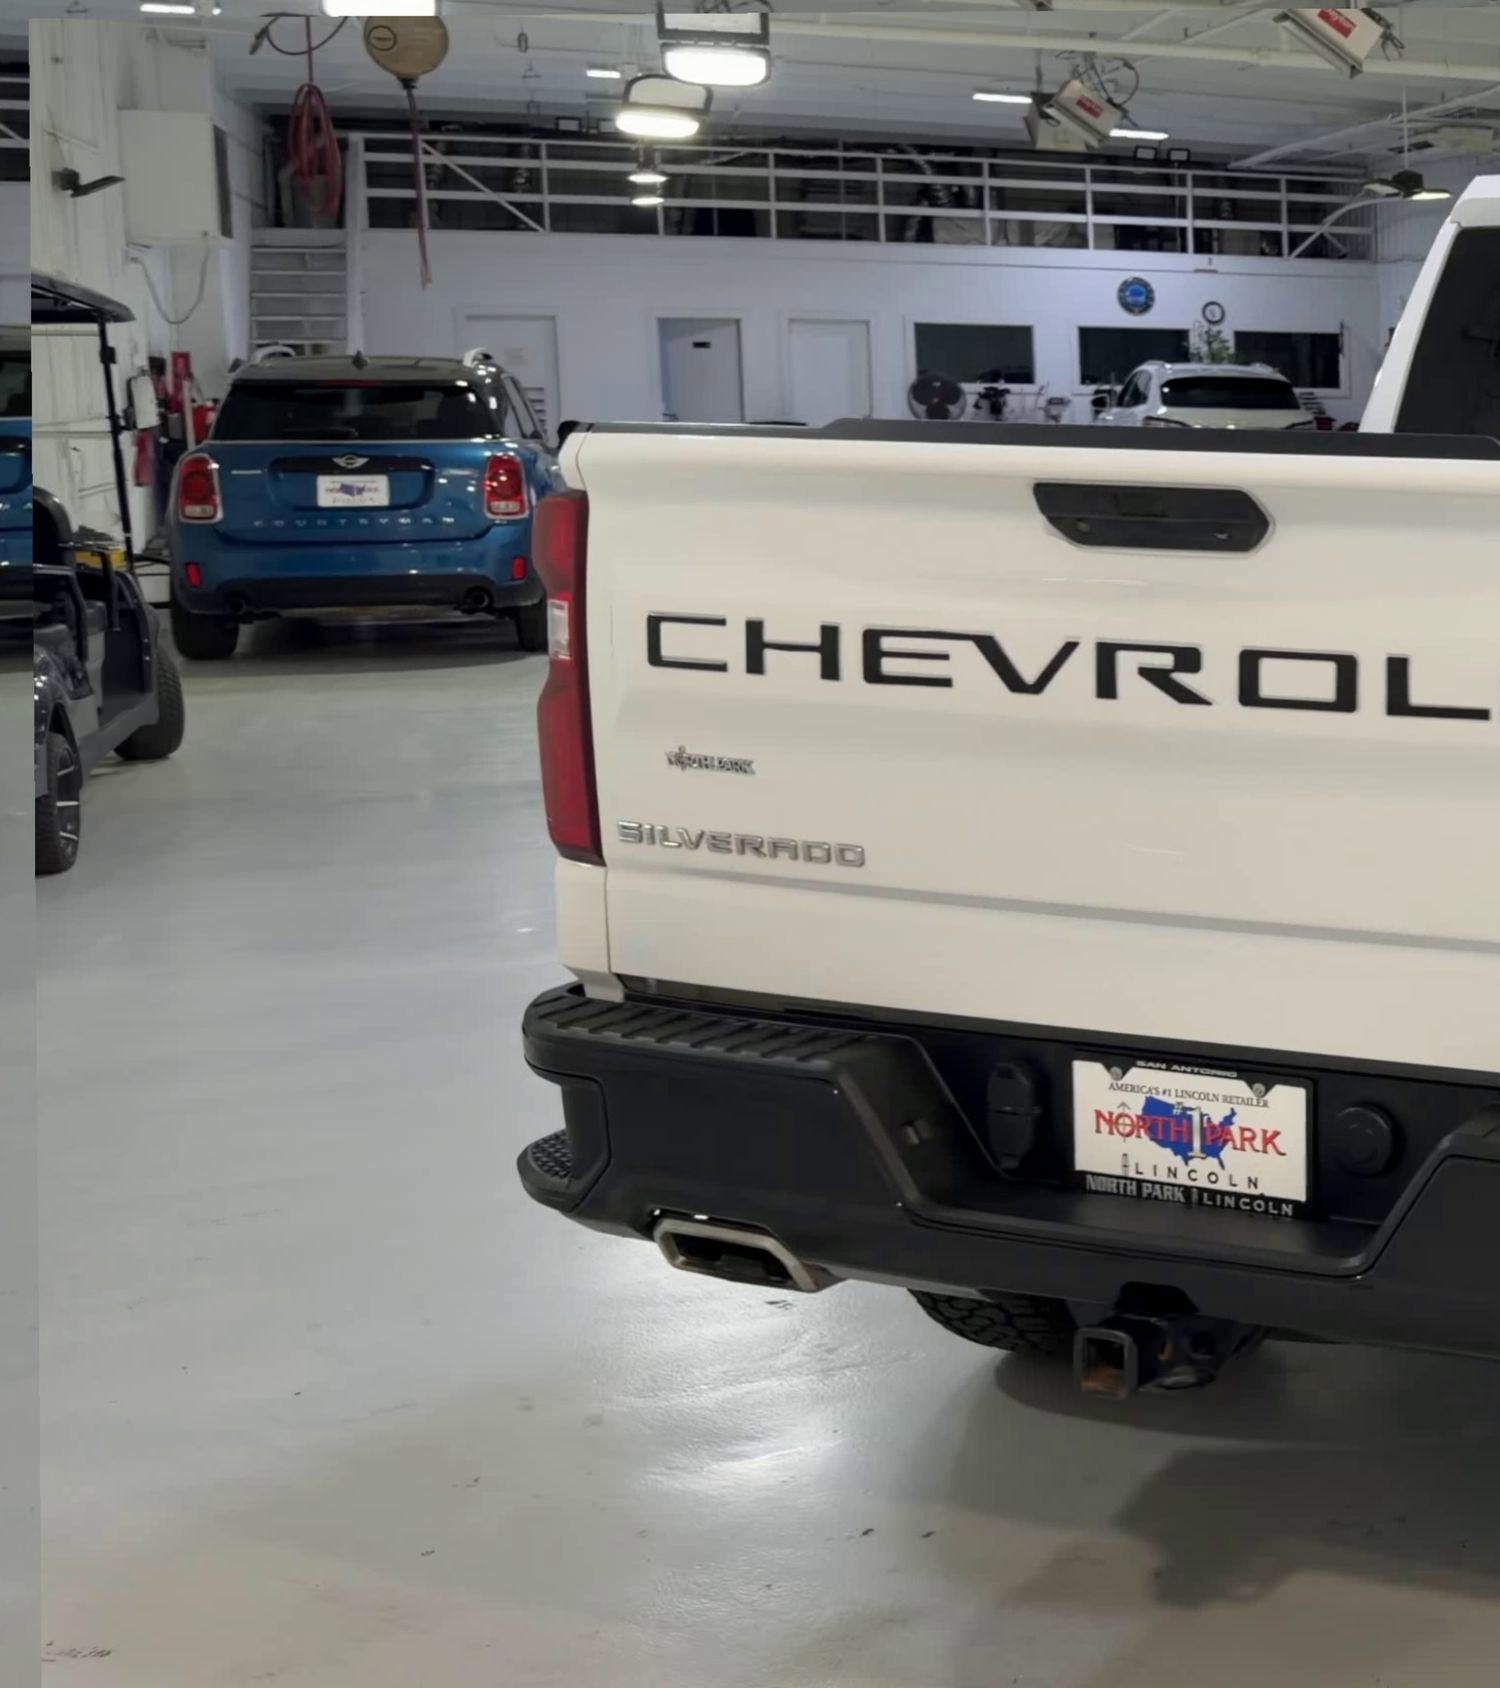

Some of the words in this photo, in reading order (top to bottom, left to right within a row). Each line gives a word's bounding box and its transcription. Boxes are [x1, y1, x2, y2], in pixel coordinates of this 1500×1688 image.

[617, 819, 867, 868] SILVERADO
[1136, 1060, 1166, 1070] SAN
[1108, 1082, 1160, 1096] AMERICA'S
[1162, 1088, 1172, 1098] #1
[1174, 1089, 1220, 1103] LINCOLN
[1222, 1094, 1270, 1109] RETAILER
[1094, 1109, 1192, 1144] NORTH
[1206, 1119, 1287, 1156] PARK
[1135, 1162, 1258, 1190] LINCOLN
[1086, 1174, 1137, 1197] NORTH
[1141, 1182, 1185, 1204] PARK
[1203, 1192, 1293, 1216] LINCOLN
